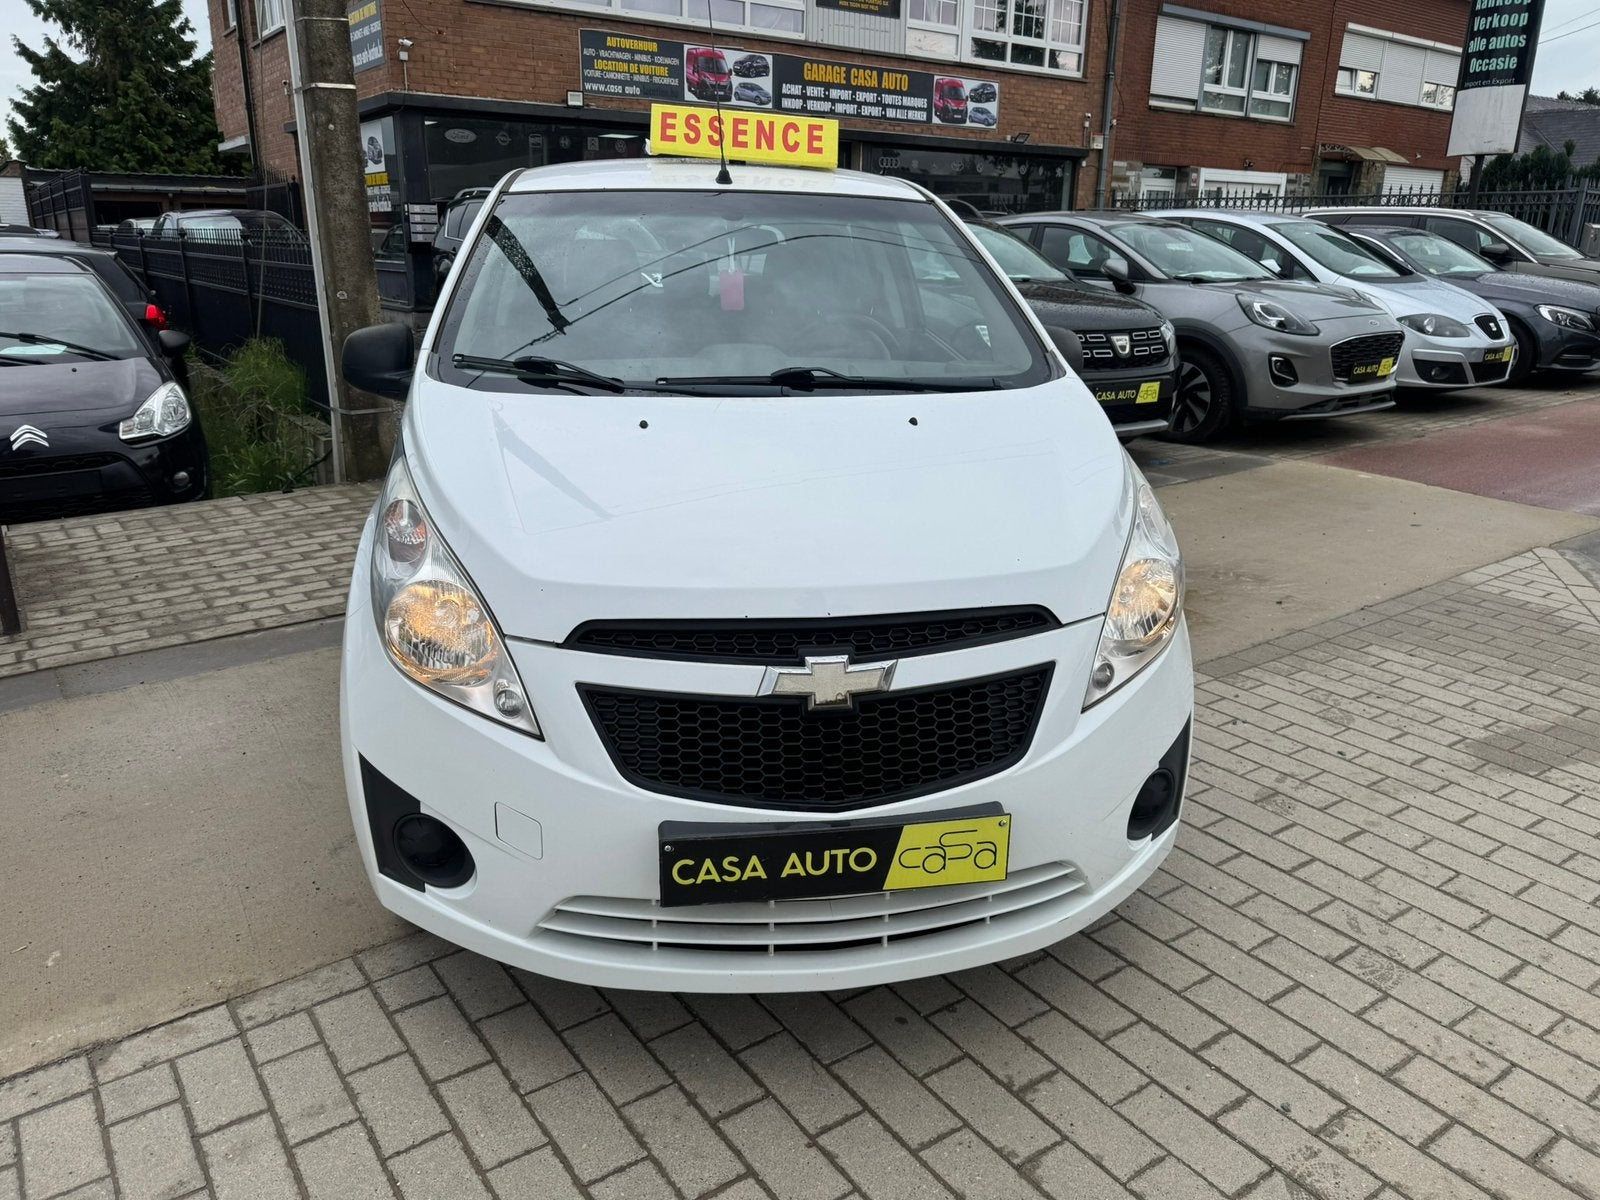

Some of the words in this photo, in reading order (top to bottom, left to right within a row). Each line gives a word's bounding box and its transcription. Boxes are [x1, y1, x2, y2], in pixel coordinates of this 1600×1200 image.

[1474, 12, 1528, 31] Verkoop
[606, 36, 658, 52] AUTOVERHUUR
[1468, 36, 1487, 53] alle
[1488, 34, 1526, 50] autos
[583, 48, 596, 56] AUTO
[599, 50, 632, 60] VRACHTWAGEN
[634, 53, 651, 62] MINIBUS
[654, 56, 680, 65] KOELWAGEN
[1469, 55, 1518, 73] Occasie
[594, 59, 629, 73] LOCATION
[630, 63, 639, 73] DE
[640, 64, 669, 77] VOITURE
[804, 62, 846, 85] GARAGE
[851, 68, 878, 88] CASA
[882, 72, 909, 92] AUTO
[625, 85, 640, 95] auto
[652, 76, 679, 86] FRIGORIFIQUE
[1492, 78, 1515, 86] Export
[781, 83, 802, 96] ACHAT
[806, 86, 824, 98] VENTE
[830, 89, 851, 101] IMPORT
[856, 91, 877, 104] EXPORT
[882, 94, 902, 106] TOUTES
[902, 96, 928, 109] MARQUES
[781, 98, 803, 110] INKOOP
[806, 100, 832, 112] VERKOOP
[835, 103, 858, 115] IMPORT
[861, 106, 882, 118] EXPORT
[886, 108, 896, 119] VAN
[896, 109, 907, 120] ALLE
[907, 110, 927, 122] MERKEN
[660, 111, 824, 154] ESSENCE
[1096, 391, 1115, 401] CASA
[1118, 390, 1136, 399] AUTO
[672, 855, 767, 885] CASA
[780, 847, 877, 878] AUTO
